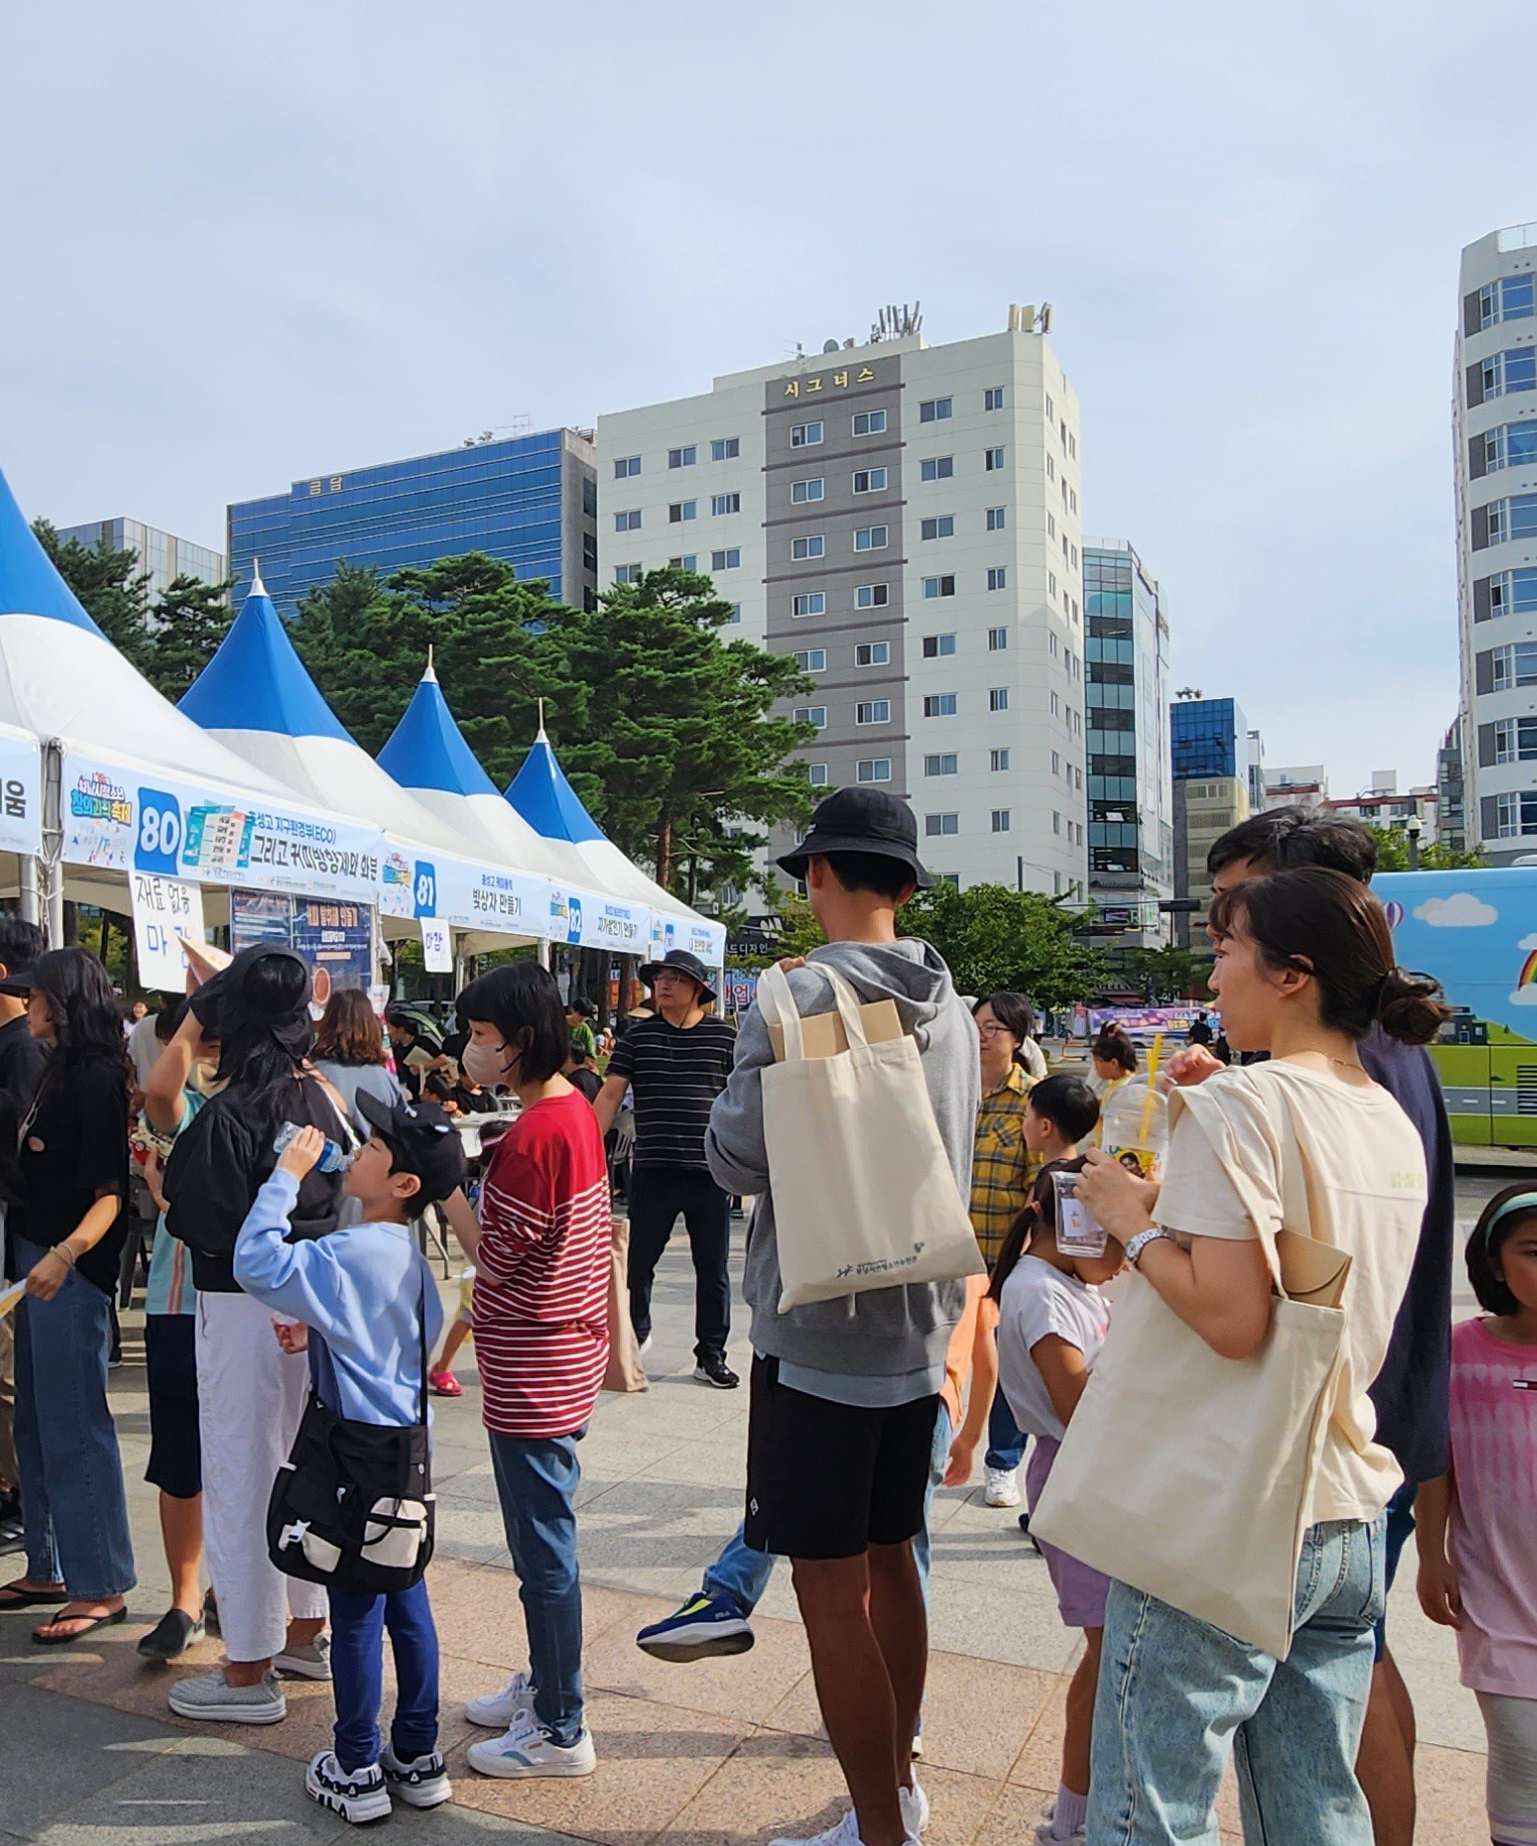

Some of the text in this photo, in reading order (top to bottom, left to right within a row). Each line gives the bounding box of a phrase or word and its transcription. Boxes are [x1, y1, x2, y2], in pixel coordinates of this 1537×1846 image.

[784, 368, 874, 398] 시그너스
[140, 806, 180, 856] 80
[250, 834, 289, 867] 그리고
[135, 875, 191, 915] 재료 없음
[416, 874, 433, 907] 81
[499, 893, 522, 917] 만들기
[570, 908, 582, 933] 82
[725, 943, 768, 956] 드디자인
